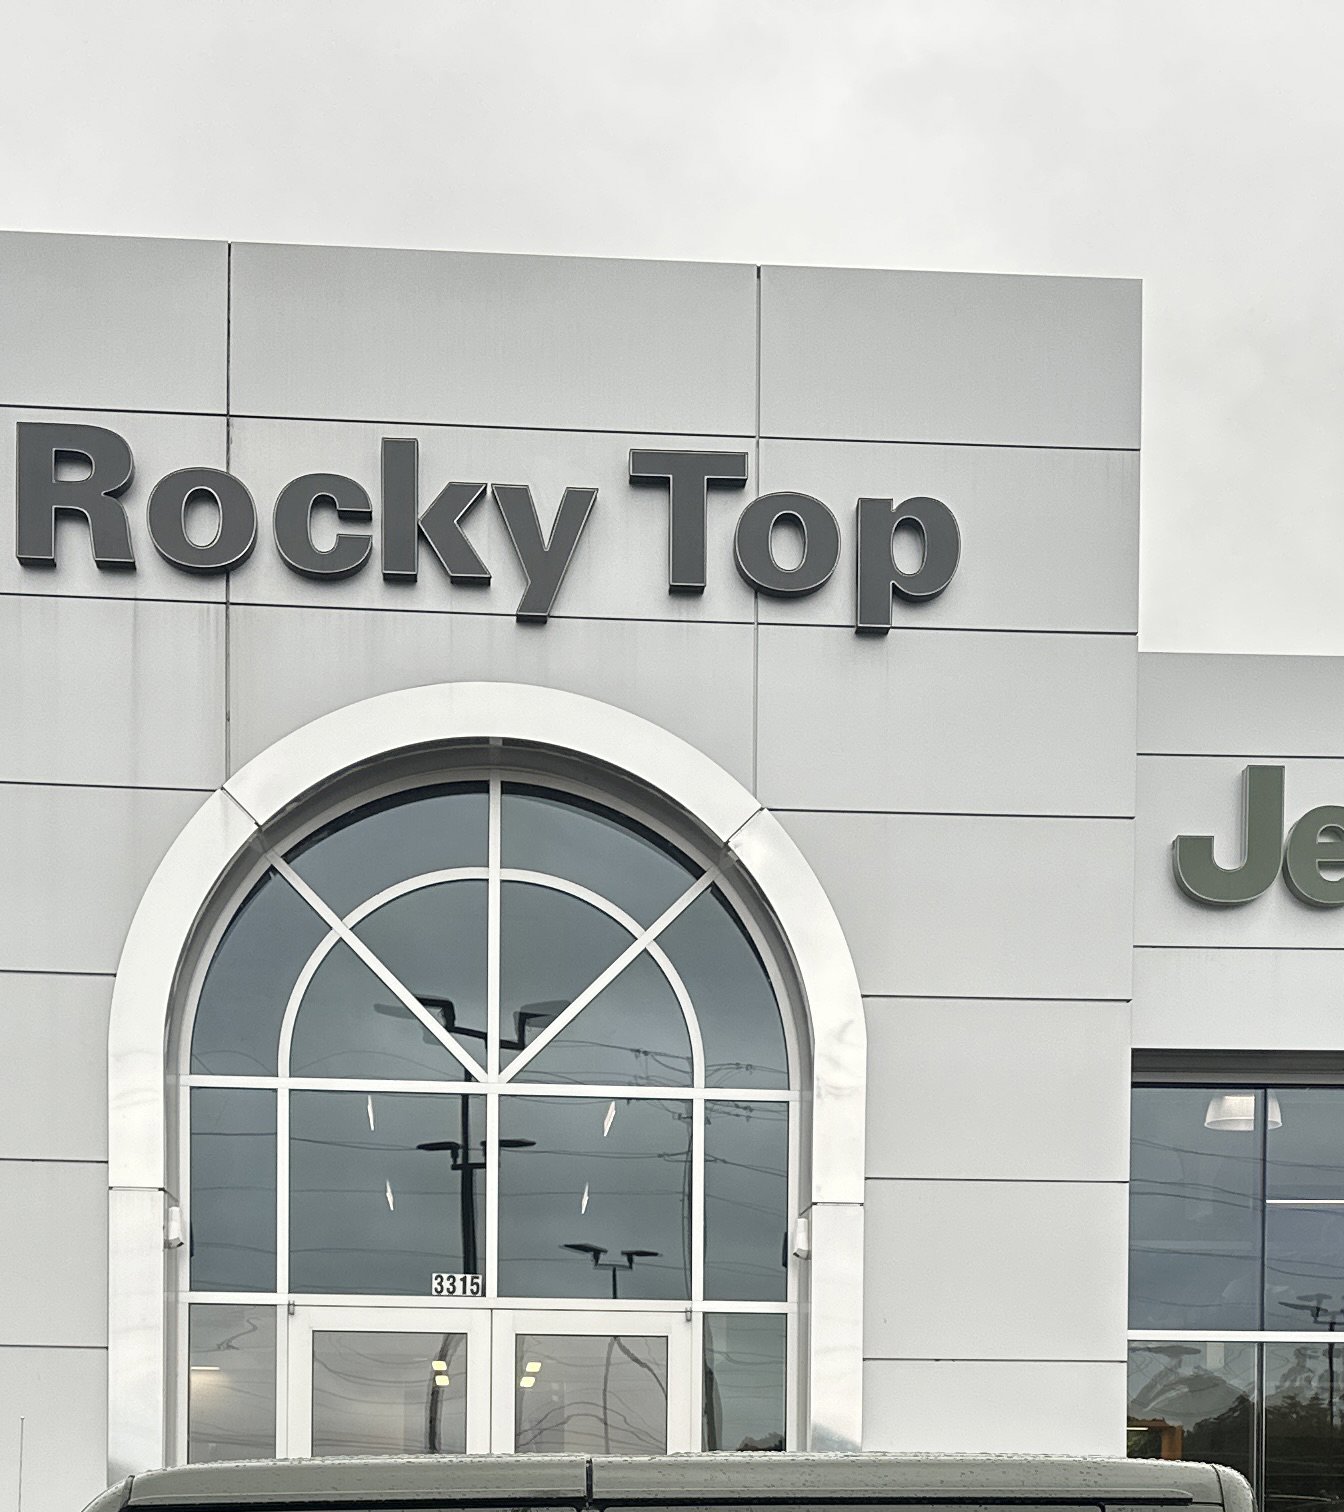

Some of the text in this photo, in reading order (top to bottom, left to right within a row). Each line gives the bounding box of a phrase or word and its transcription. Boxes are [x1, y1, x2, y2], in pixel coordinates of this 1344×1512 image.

[16, 421, 961, 634] Rocky Top
[433, 1273, 481, 1296] 3315
